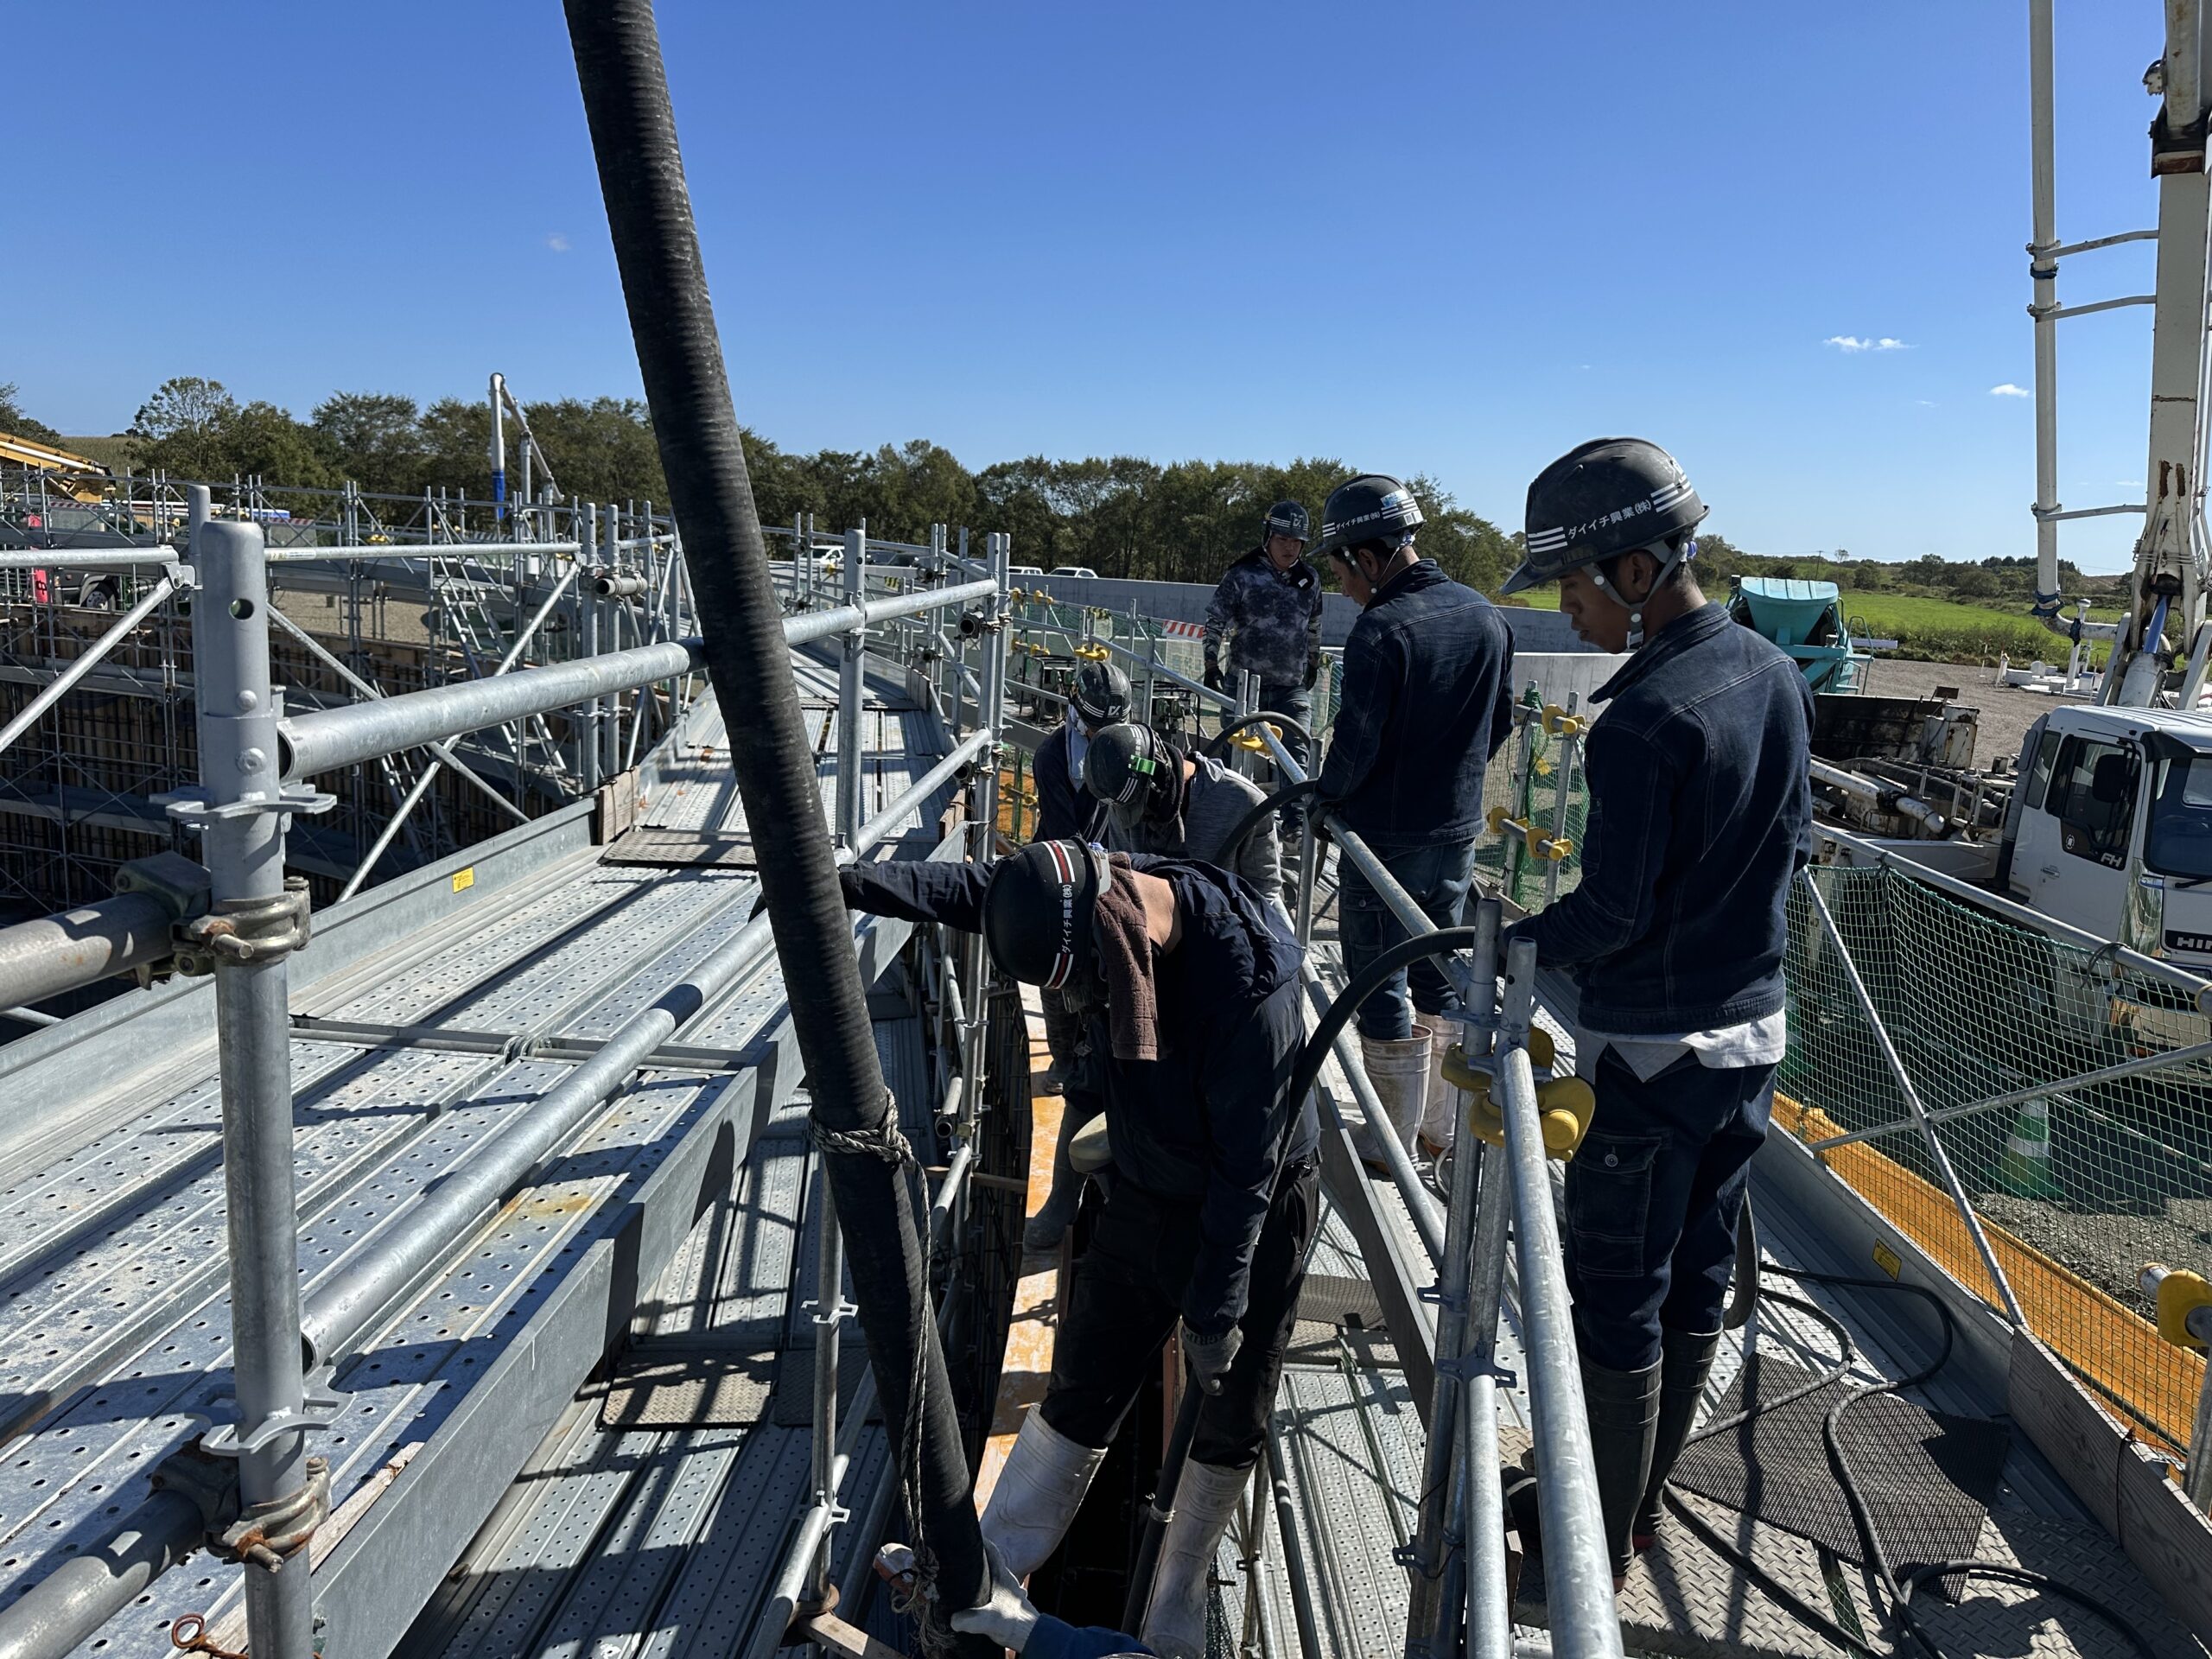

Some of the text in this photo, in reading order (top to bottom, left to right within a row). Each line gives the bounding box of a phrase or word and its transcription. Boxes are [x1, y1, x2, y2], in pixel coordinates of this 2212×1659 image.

[1567, 499, 1651, 539] ダイイチ興業(株)
[2101, 852, 2123, 868] FH
